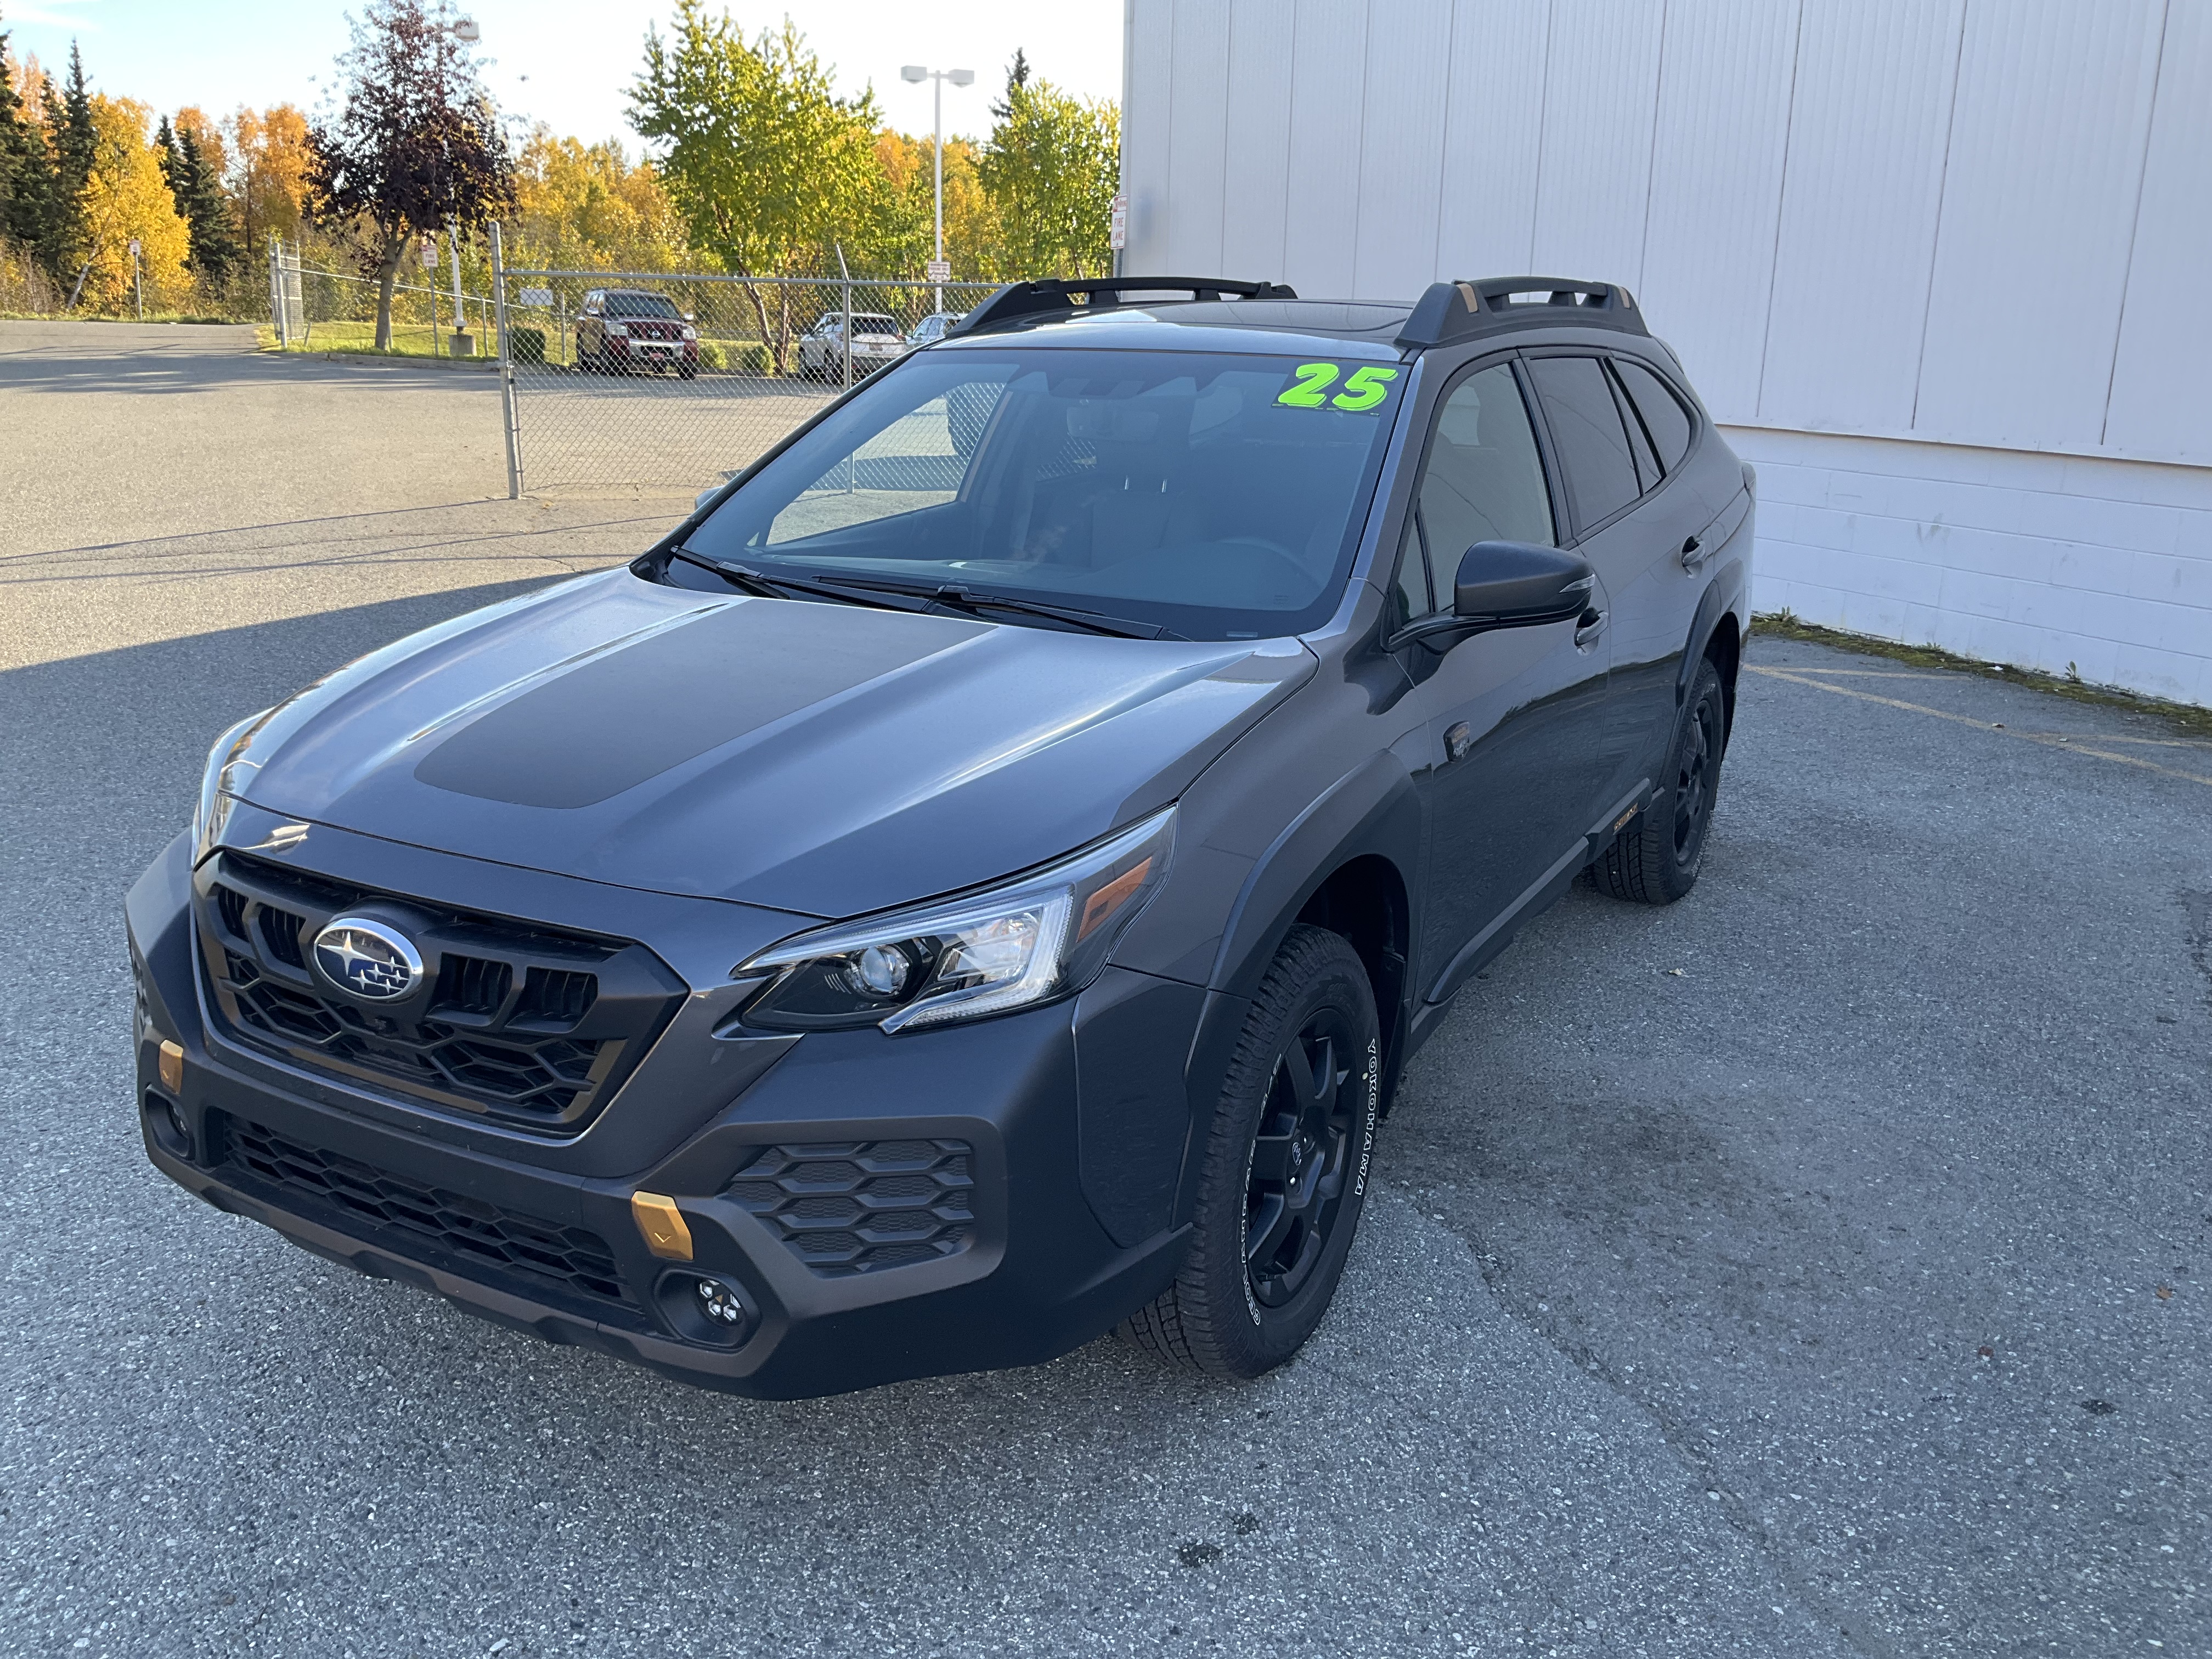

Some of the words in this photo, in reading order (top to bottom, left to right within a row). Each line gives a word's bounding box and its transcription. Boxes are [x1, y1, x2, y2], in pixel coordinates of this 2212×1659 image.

[1113, 230, 1124, 241] LANE
[1114, 217, 1124, 228] FIRE
[1278, 363, 1398, 411] 25
[1355, 1037, 1377, 1195] YOKOHAMA
